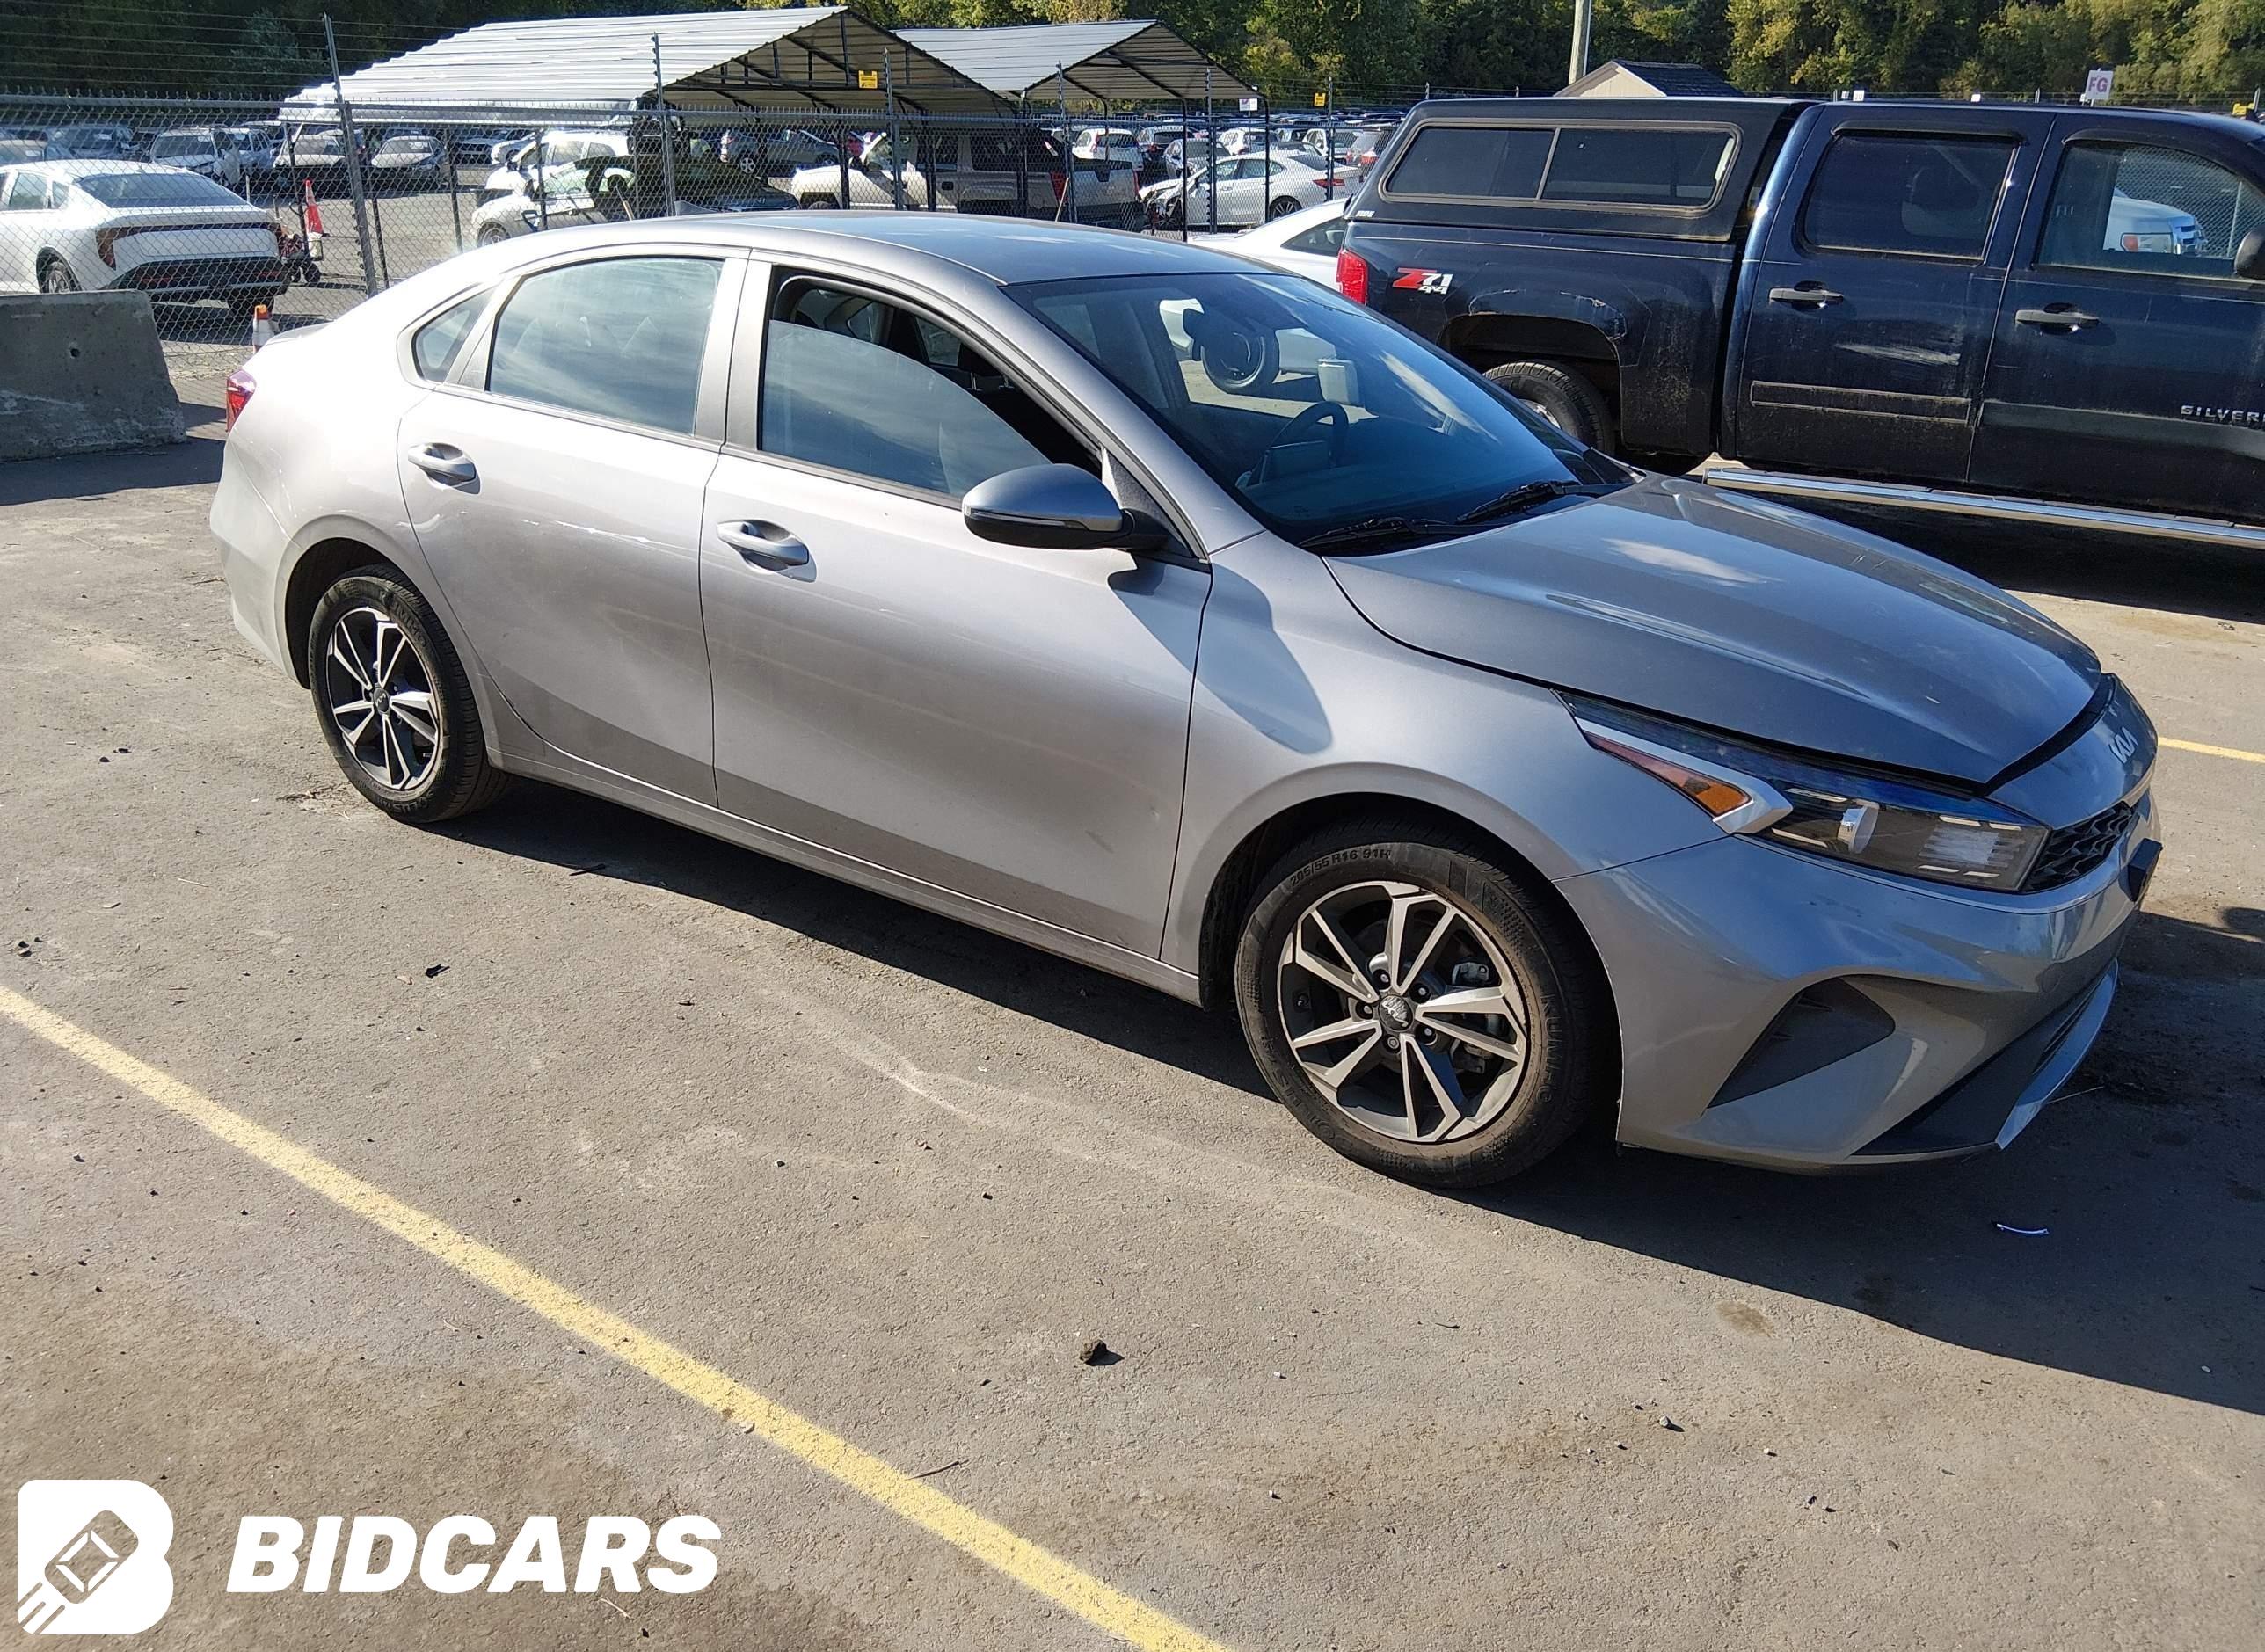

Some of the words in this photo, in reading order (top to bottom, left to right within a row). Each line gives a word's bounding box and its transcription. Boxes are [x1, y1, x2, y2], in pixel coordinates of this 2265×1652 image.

[2088, 76, 2108, 92] FG
[1392, 267, 1453, 289] Z71
[2181, 405, 2265, 422] SILVER
[2110, 726, 2139, 764] KIA
[1290, 856, 1330, 886] 205/55
[1331, 849, 1358, 864] R16
[1362, 848, 1392, 860] 91H
